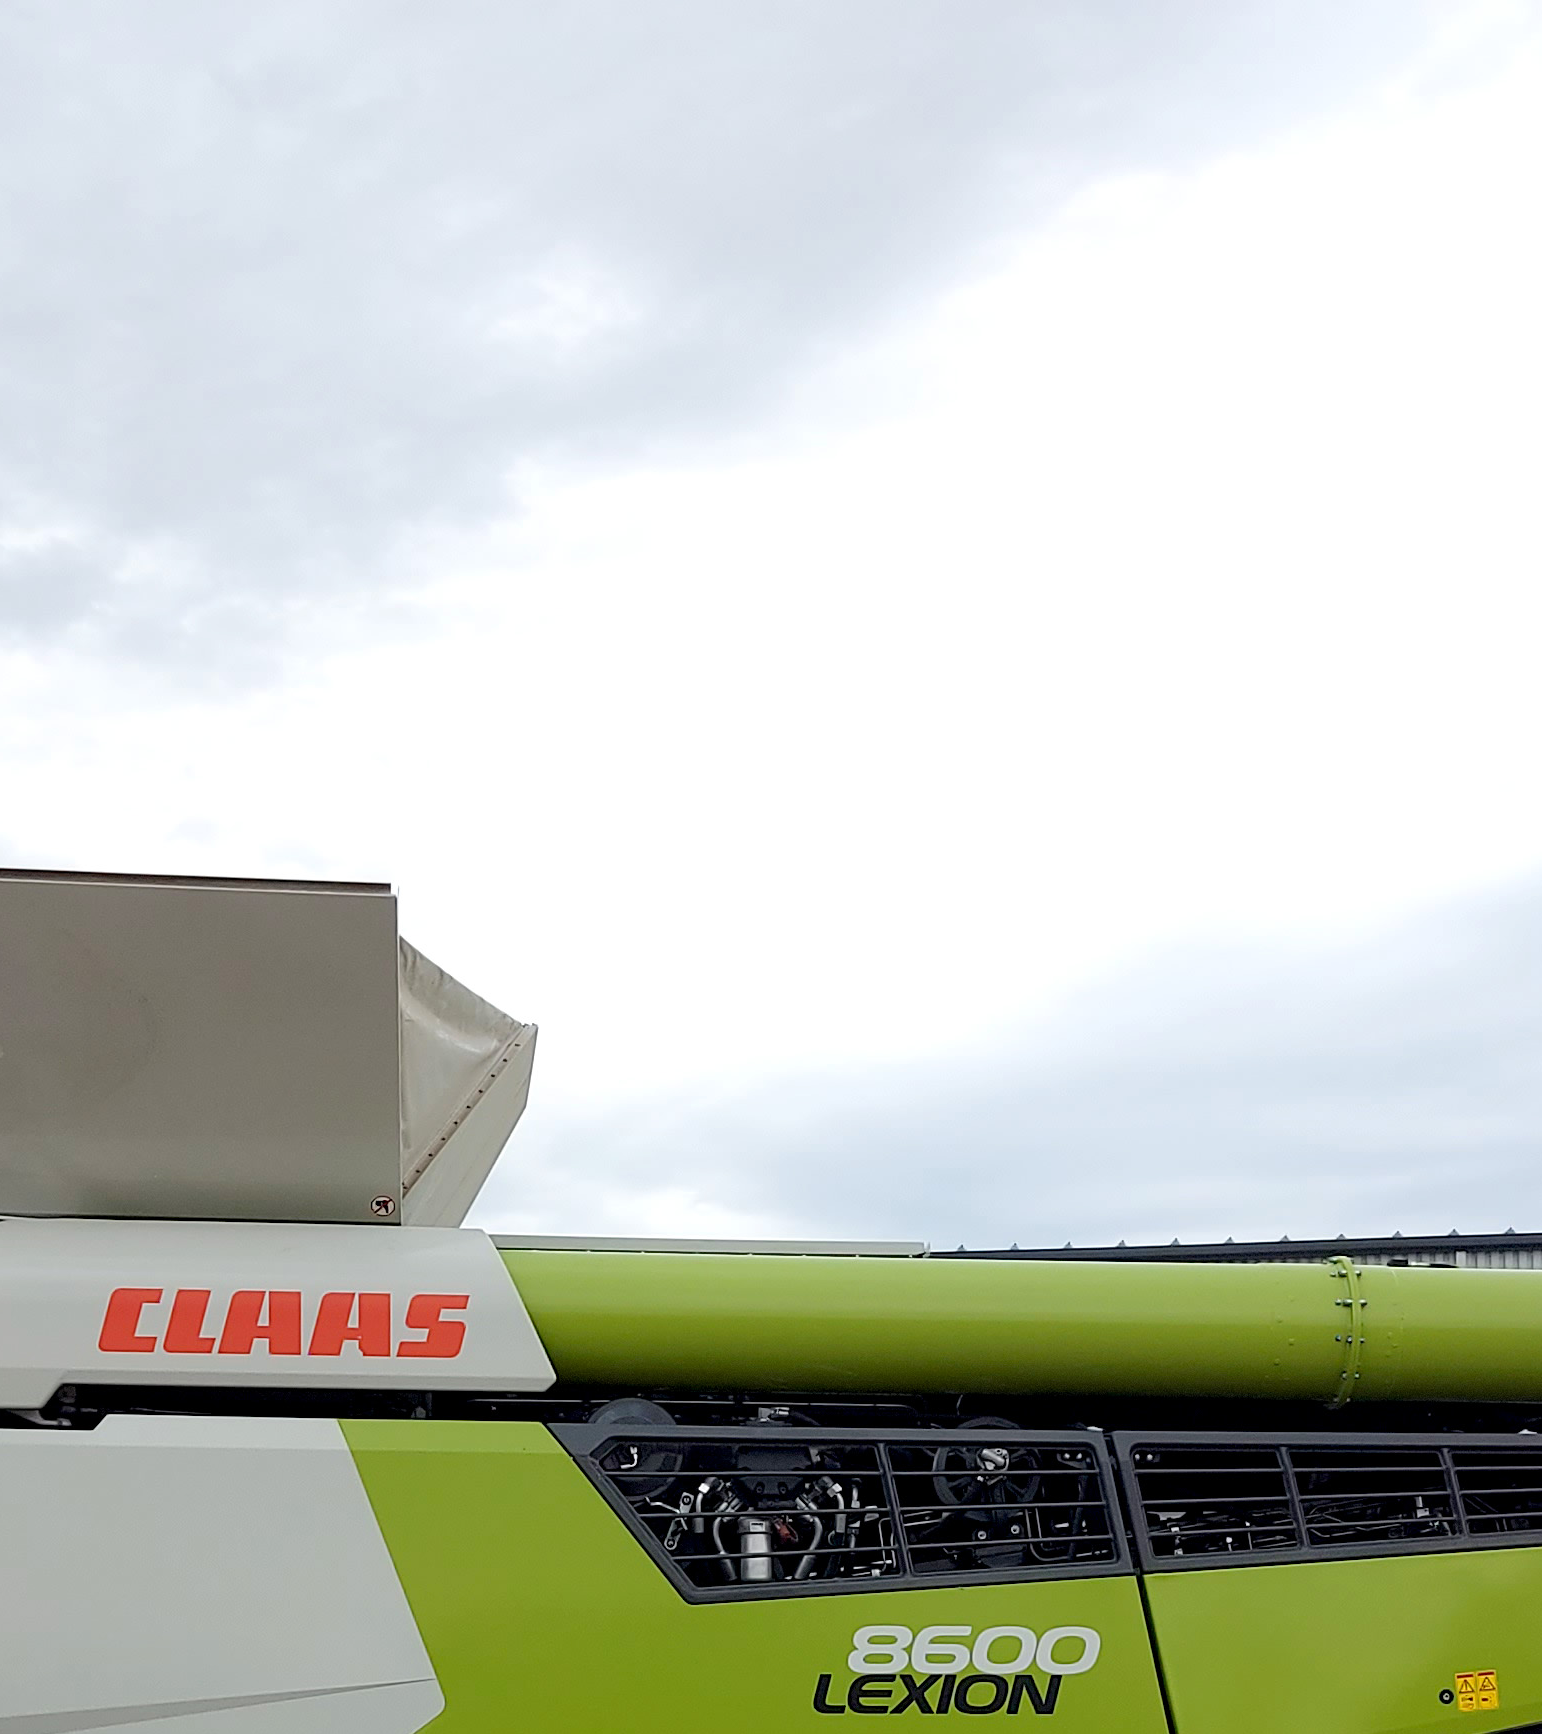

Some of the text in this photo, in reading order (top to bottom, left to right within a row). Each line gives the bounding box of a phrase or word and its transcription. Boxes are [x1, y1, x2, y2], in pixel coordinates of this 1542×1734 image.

[97, 1287, 471, 1358] CLAAS
[847, 1624, 1102, 1675] 8600
[812, 1672, 1063, 1715] LEXION
